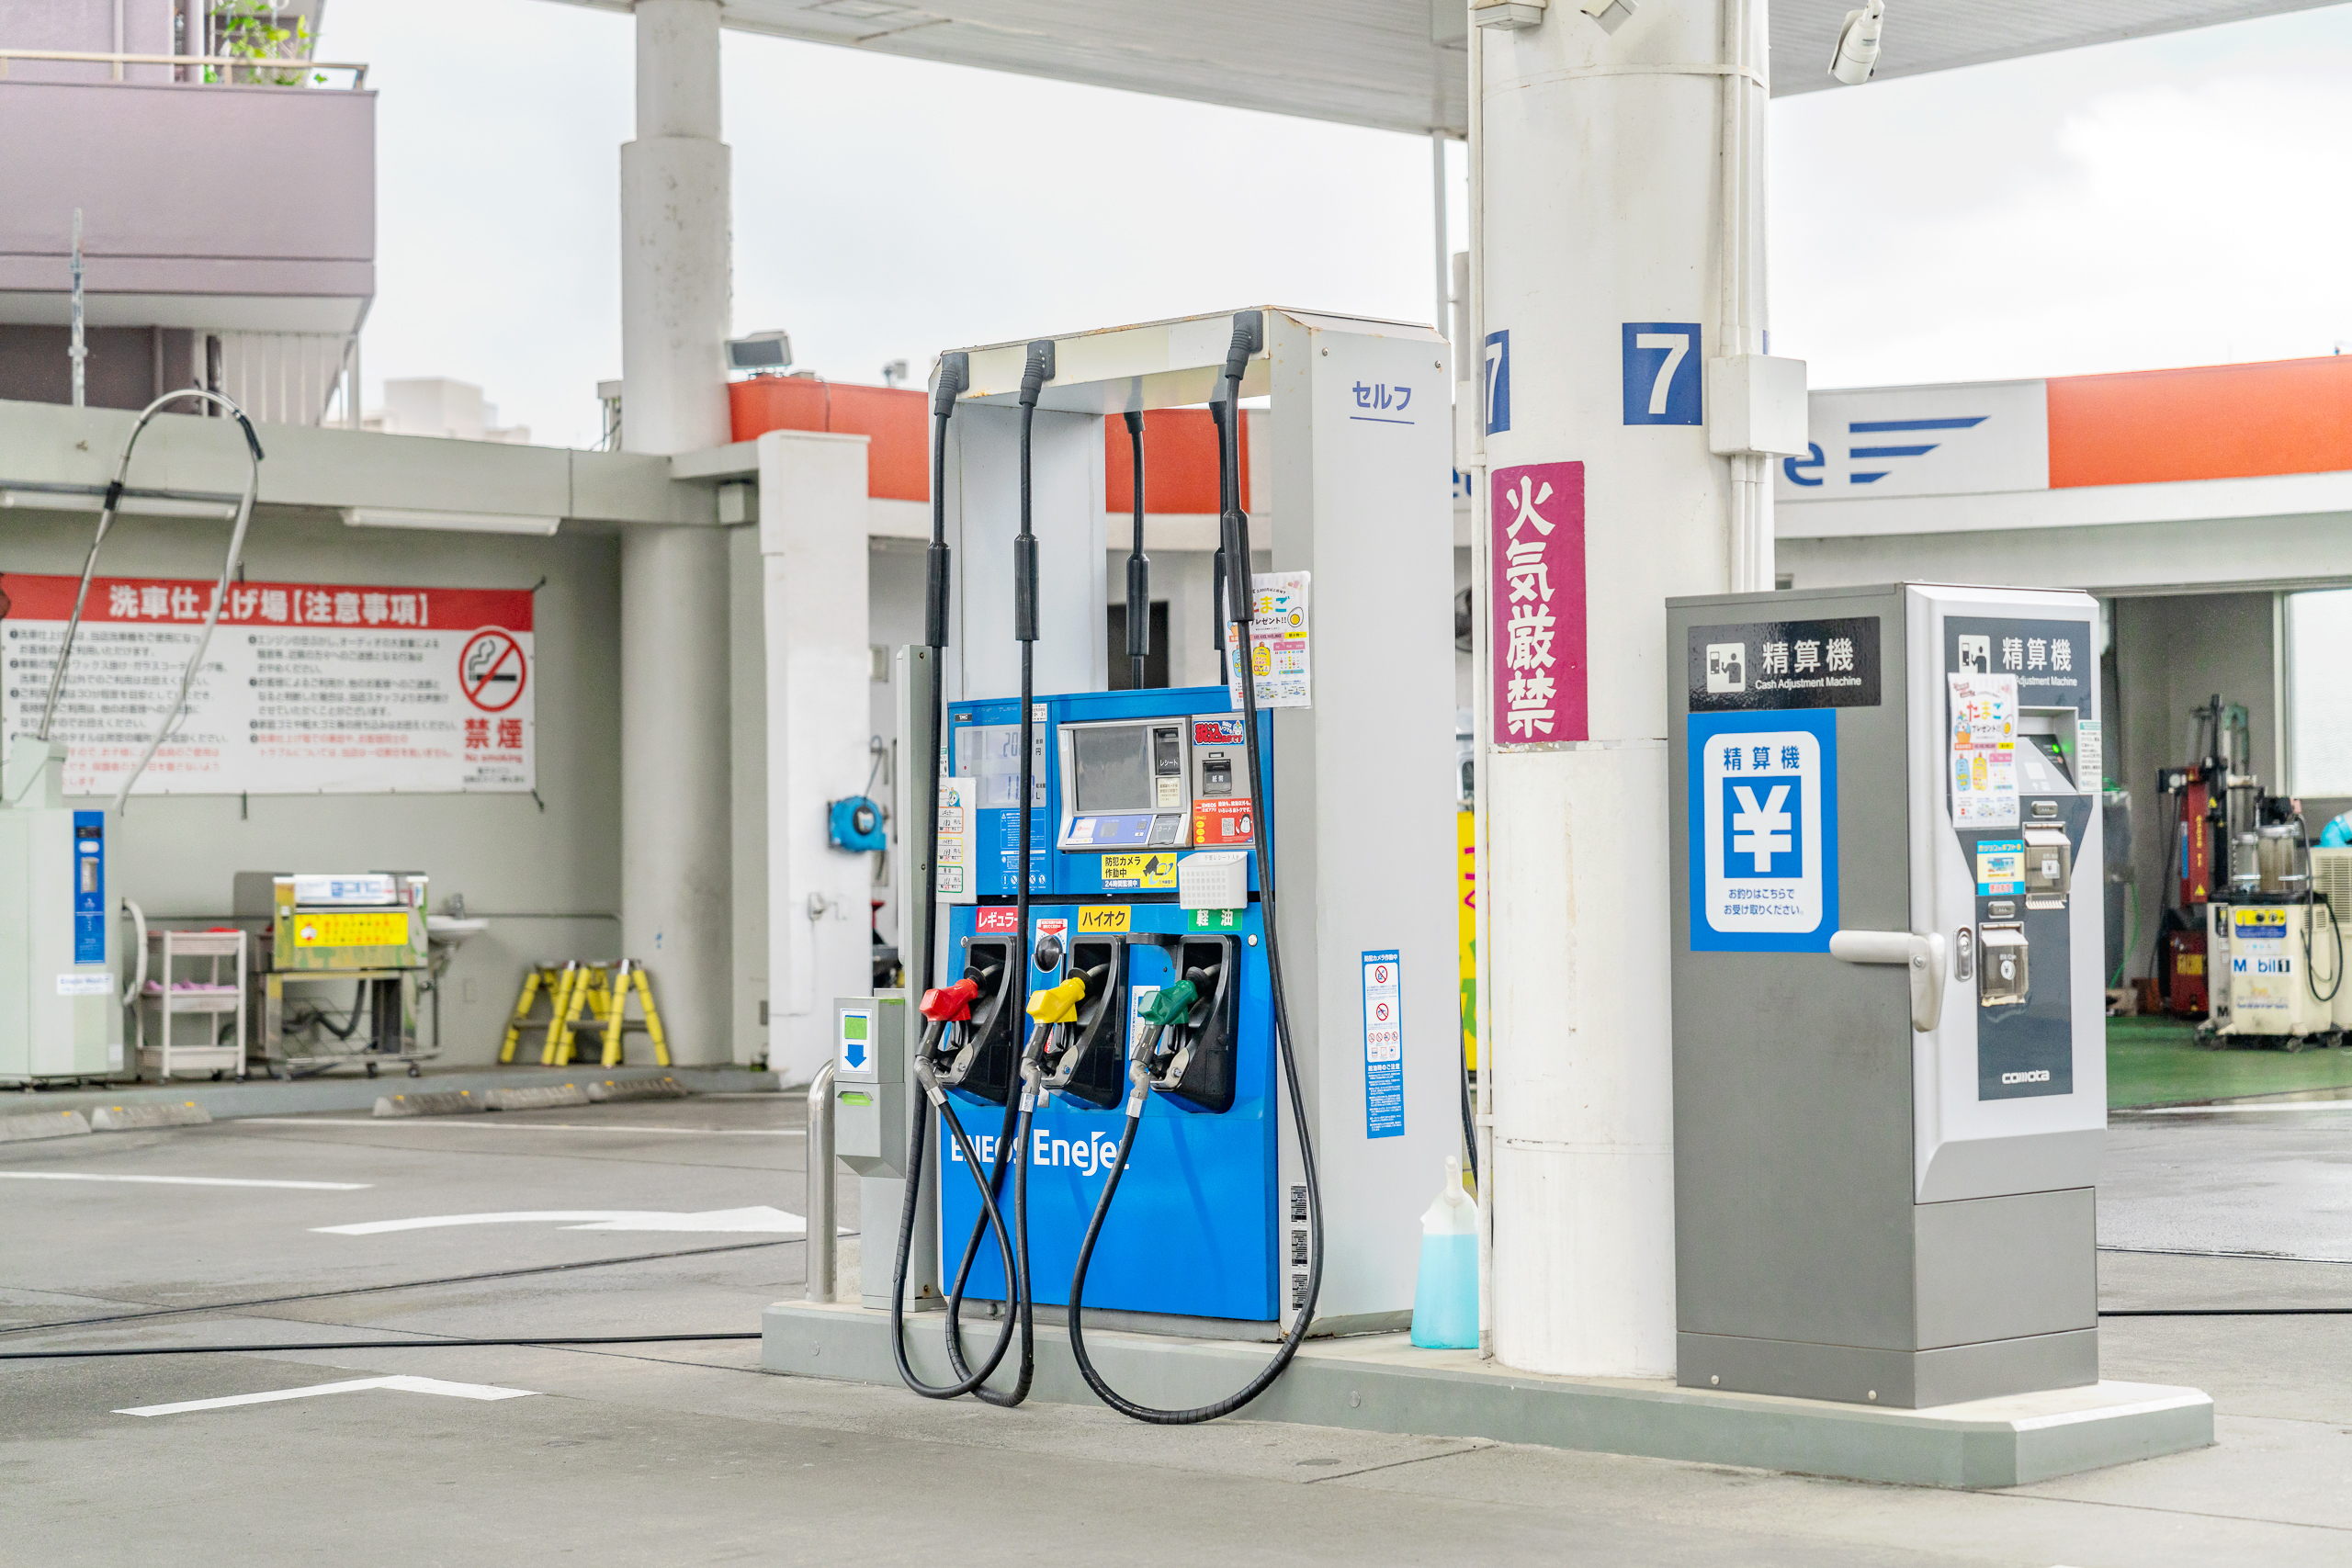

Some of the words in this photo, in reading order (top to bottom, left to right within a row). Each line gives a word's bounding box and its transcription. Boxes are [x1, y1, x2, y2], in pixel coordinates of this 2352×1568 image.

[1486, 342, 1503, 424] 7
[1636, 333, 1690, 414] 7
[1352, 380, 1412, 412] セルフ
[1505, 475, 1556, 738] 火気厳禁
[1761, 637, 1854, 675] 精算機
[2001, 637, 2073, 672] 精算機
[1755, 680, 1777, 690] Cash
[1778, 678, 1824, 691] Adjustment
[1826, 676, 1862, 687] Machine
[2052, 677, 2077, 687] Machine
[1967, 701, 2004, 722] たまご
[1194, 723, 1222, 743] 税込
[1723, 744, 1801, 773] 精算機
[1105, 856, 1141, 866] 防犯カメラ
[1105, 868, 1127, 878] 作動中
[1728, 887, 1795, 901] お釣りはこちらで
[1082, 909, 1125, 927] ハイオク
[1196, 909, 1233, 927] 軽油
[1724, 903, 1805, 916] お受け取りください。
